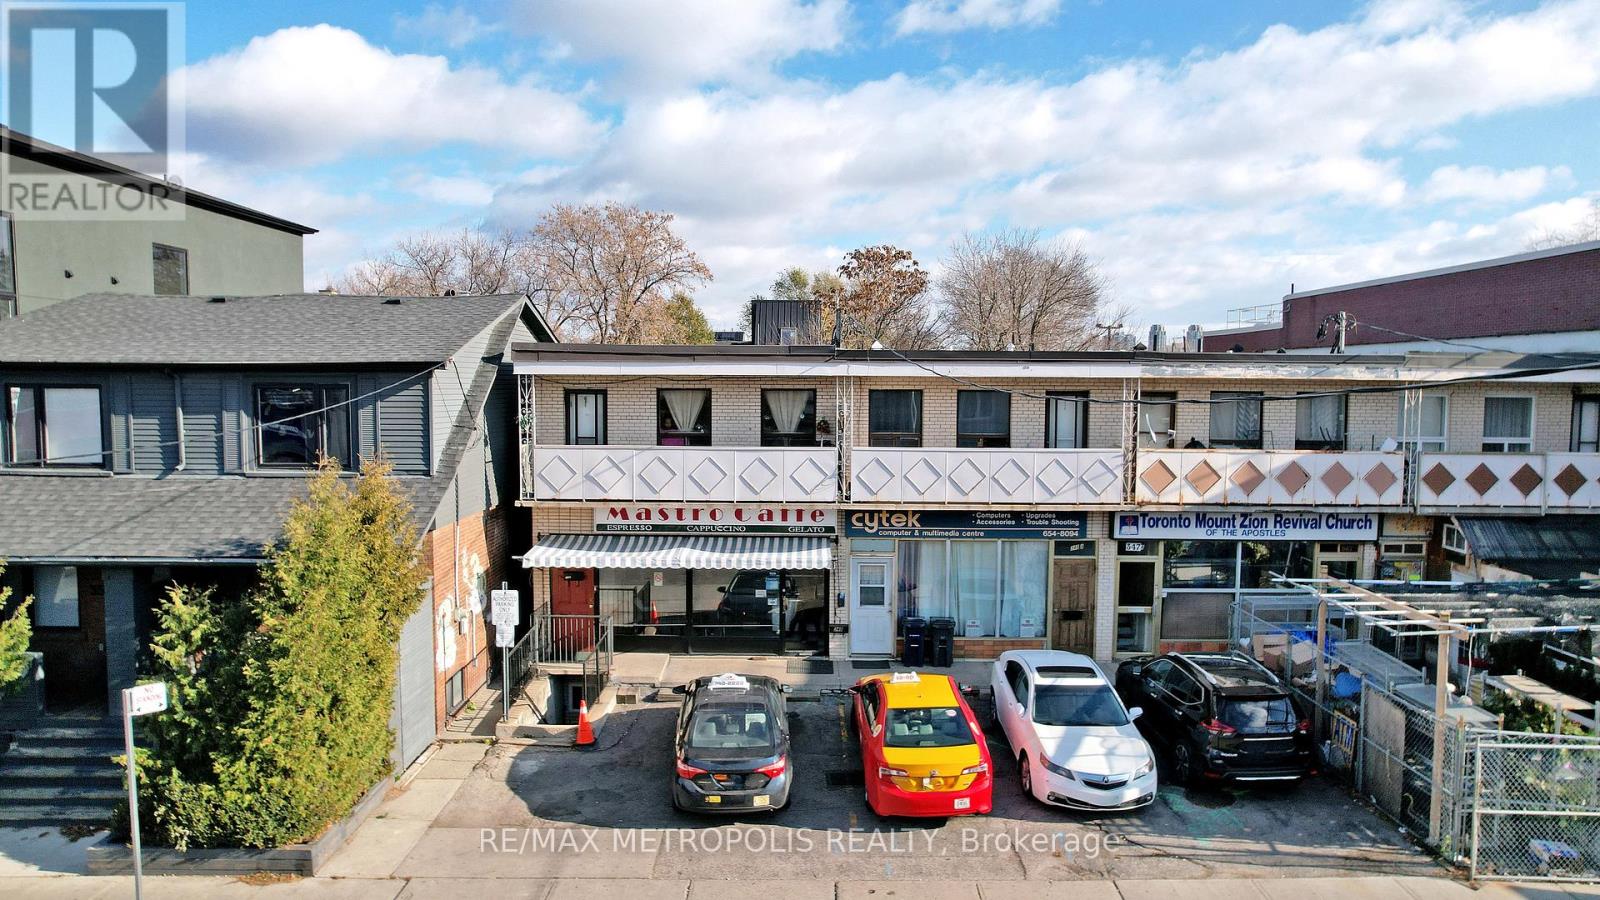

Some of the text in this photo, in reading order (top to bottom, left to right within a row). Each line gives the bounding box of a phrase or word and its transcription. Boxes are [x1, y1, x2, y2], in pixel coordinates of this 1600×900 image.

[607, 507, 724, 521] Mastro
[851, 510, 921, 533] cytek
[1139, 513, 1373, 530] Toronto Mount Zion Revival Church
[878, 529, 912, 537] computer
[922, 529, 960, 537] multimedia
[1241, 529, 1286, 537] APOSTLES
